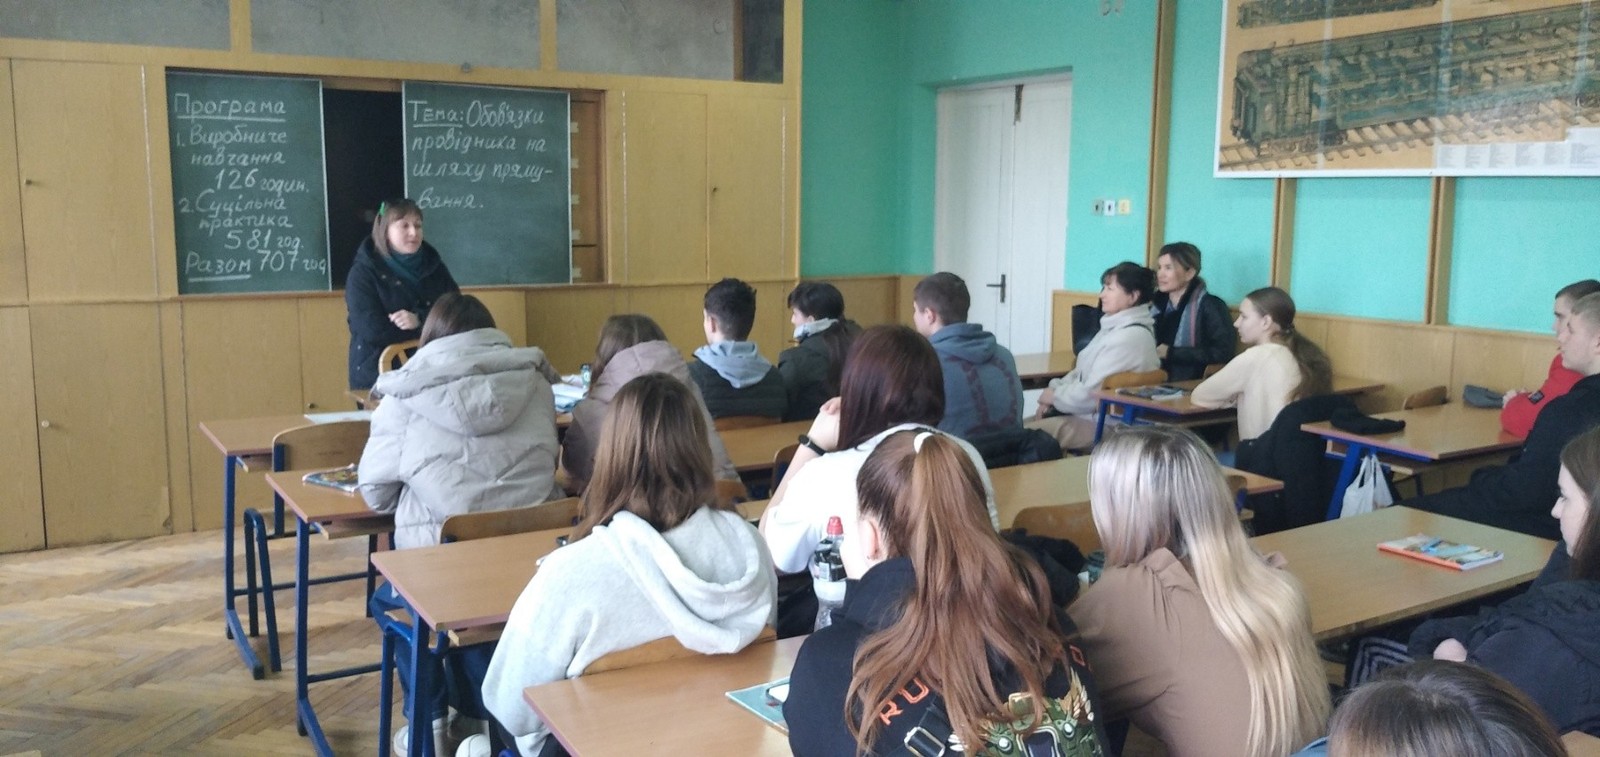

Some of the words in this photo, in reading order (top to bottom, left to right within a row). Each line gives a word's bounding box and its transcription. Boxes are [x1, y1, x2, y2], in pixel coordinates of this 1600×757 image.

[174, 93, 286, 122] Програма
[190, 123, 287, 149] Виробниче
[411, 127, 516, 163] провідника
[526, 137, 547, 153] на
[191, 147, 286, 166] навчання
[215, 168, 258, 190] 126
[413, 160, 486, 182] шляху
[492, 160, 553, 182] пряму-
[179, 198, 194, 213] 2.
[195, 188, 286, 218] Суцільна
[416, 186, 484, 210] вання.
[199, 214, 293, 237] практика
[224, 229, 272, 250] 581
[185, 251, 251, 275] Разом
[257, 249, 300, 272] 707
[303, 258, 326, 275] год
